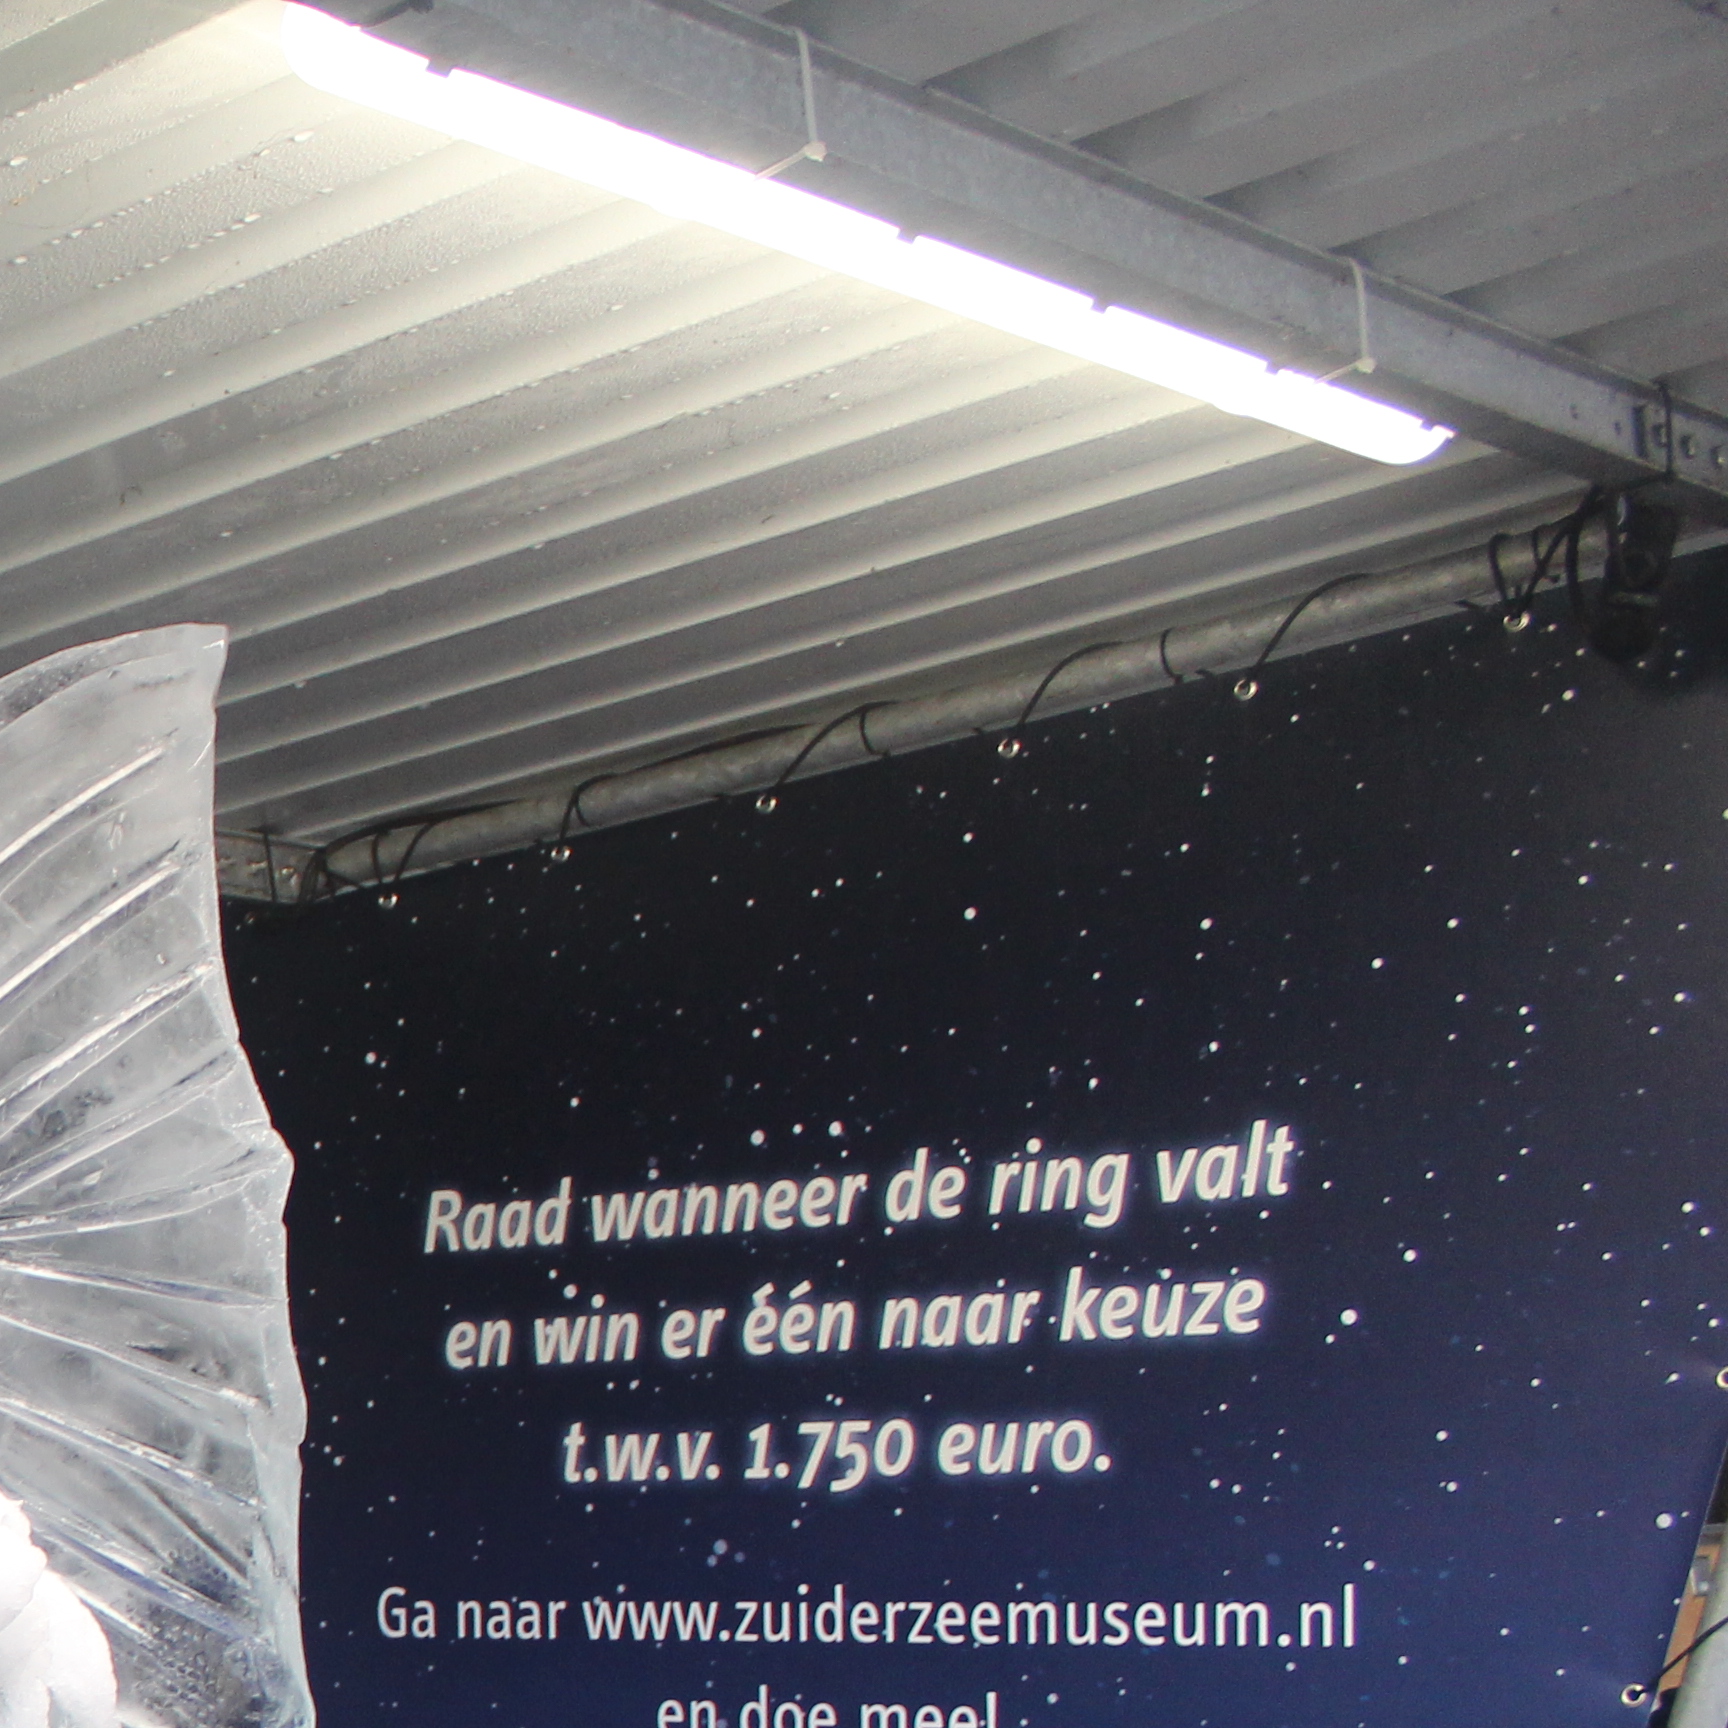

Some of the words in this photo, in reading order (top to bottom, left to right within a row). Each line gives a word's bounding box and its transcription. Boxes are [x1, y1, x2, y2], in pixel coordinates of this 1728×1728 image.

[423, 1175, 573, 1255] Raad
[590, 1173, 869, 1243] wanneer
[884, 1146, 967, 1224] de
[987, 1137, 1131, 1230] ring
[1155, 1118, 1296, 1204] valt
[444, 1318, 512, 1371] en
[533, 1296, 640, 1366] win
[660, 1306, 727, 1361] er
[741, 1279, 856, 1357] één
[878, 1290, 1042, 1351] naar
[1058, 1265, 1267, 1343] keuze
[562, 1421, 721, 1484] t.w.v.
[743, 1417, 916, 1494] 1.750
[936, 1418, 1114, 1477] euro.
[376, 1586, 438, 1642] Ga
[455, 1596, 567, 1642] naar
[581, 1582, 1357, 1648] www.zuiderzeemuseum.nl
